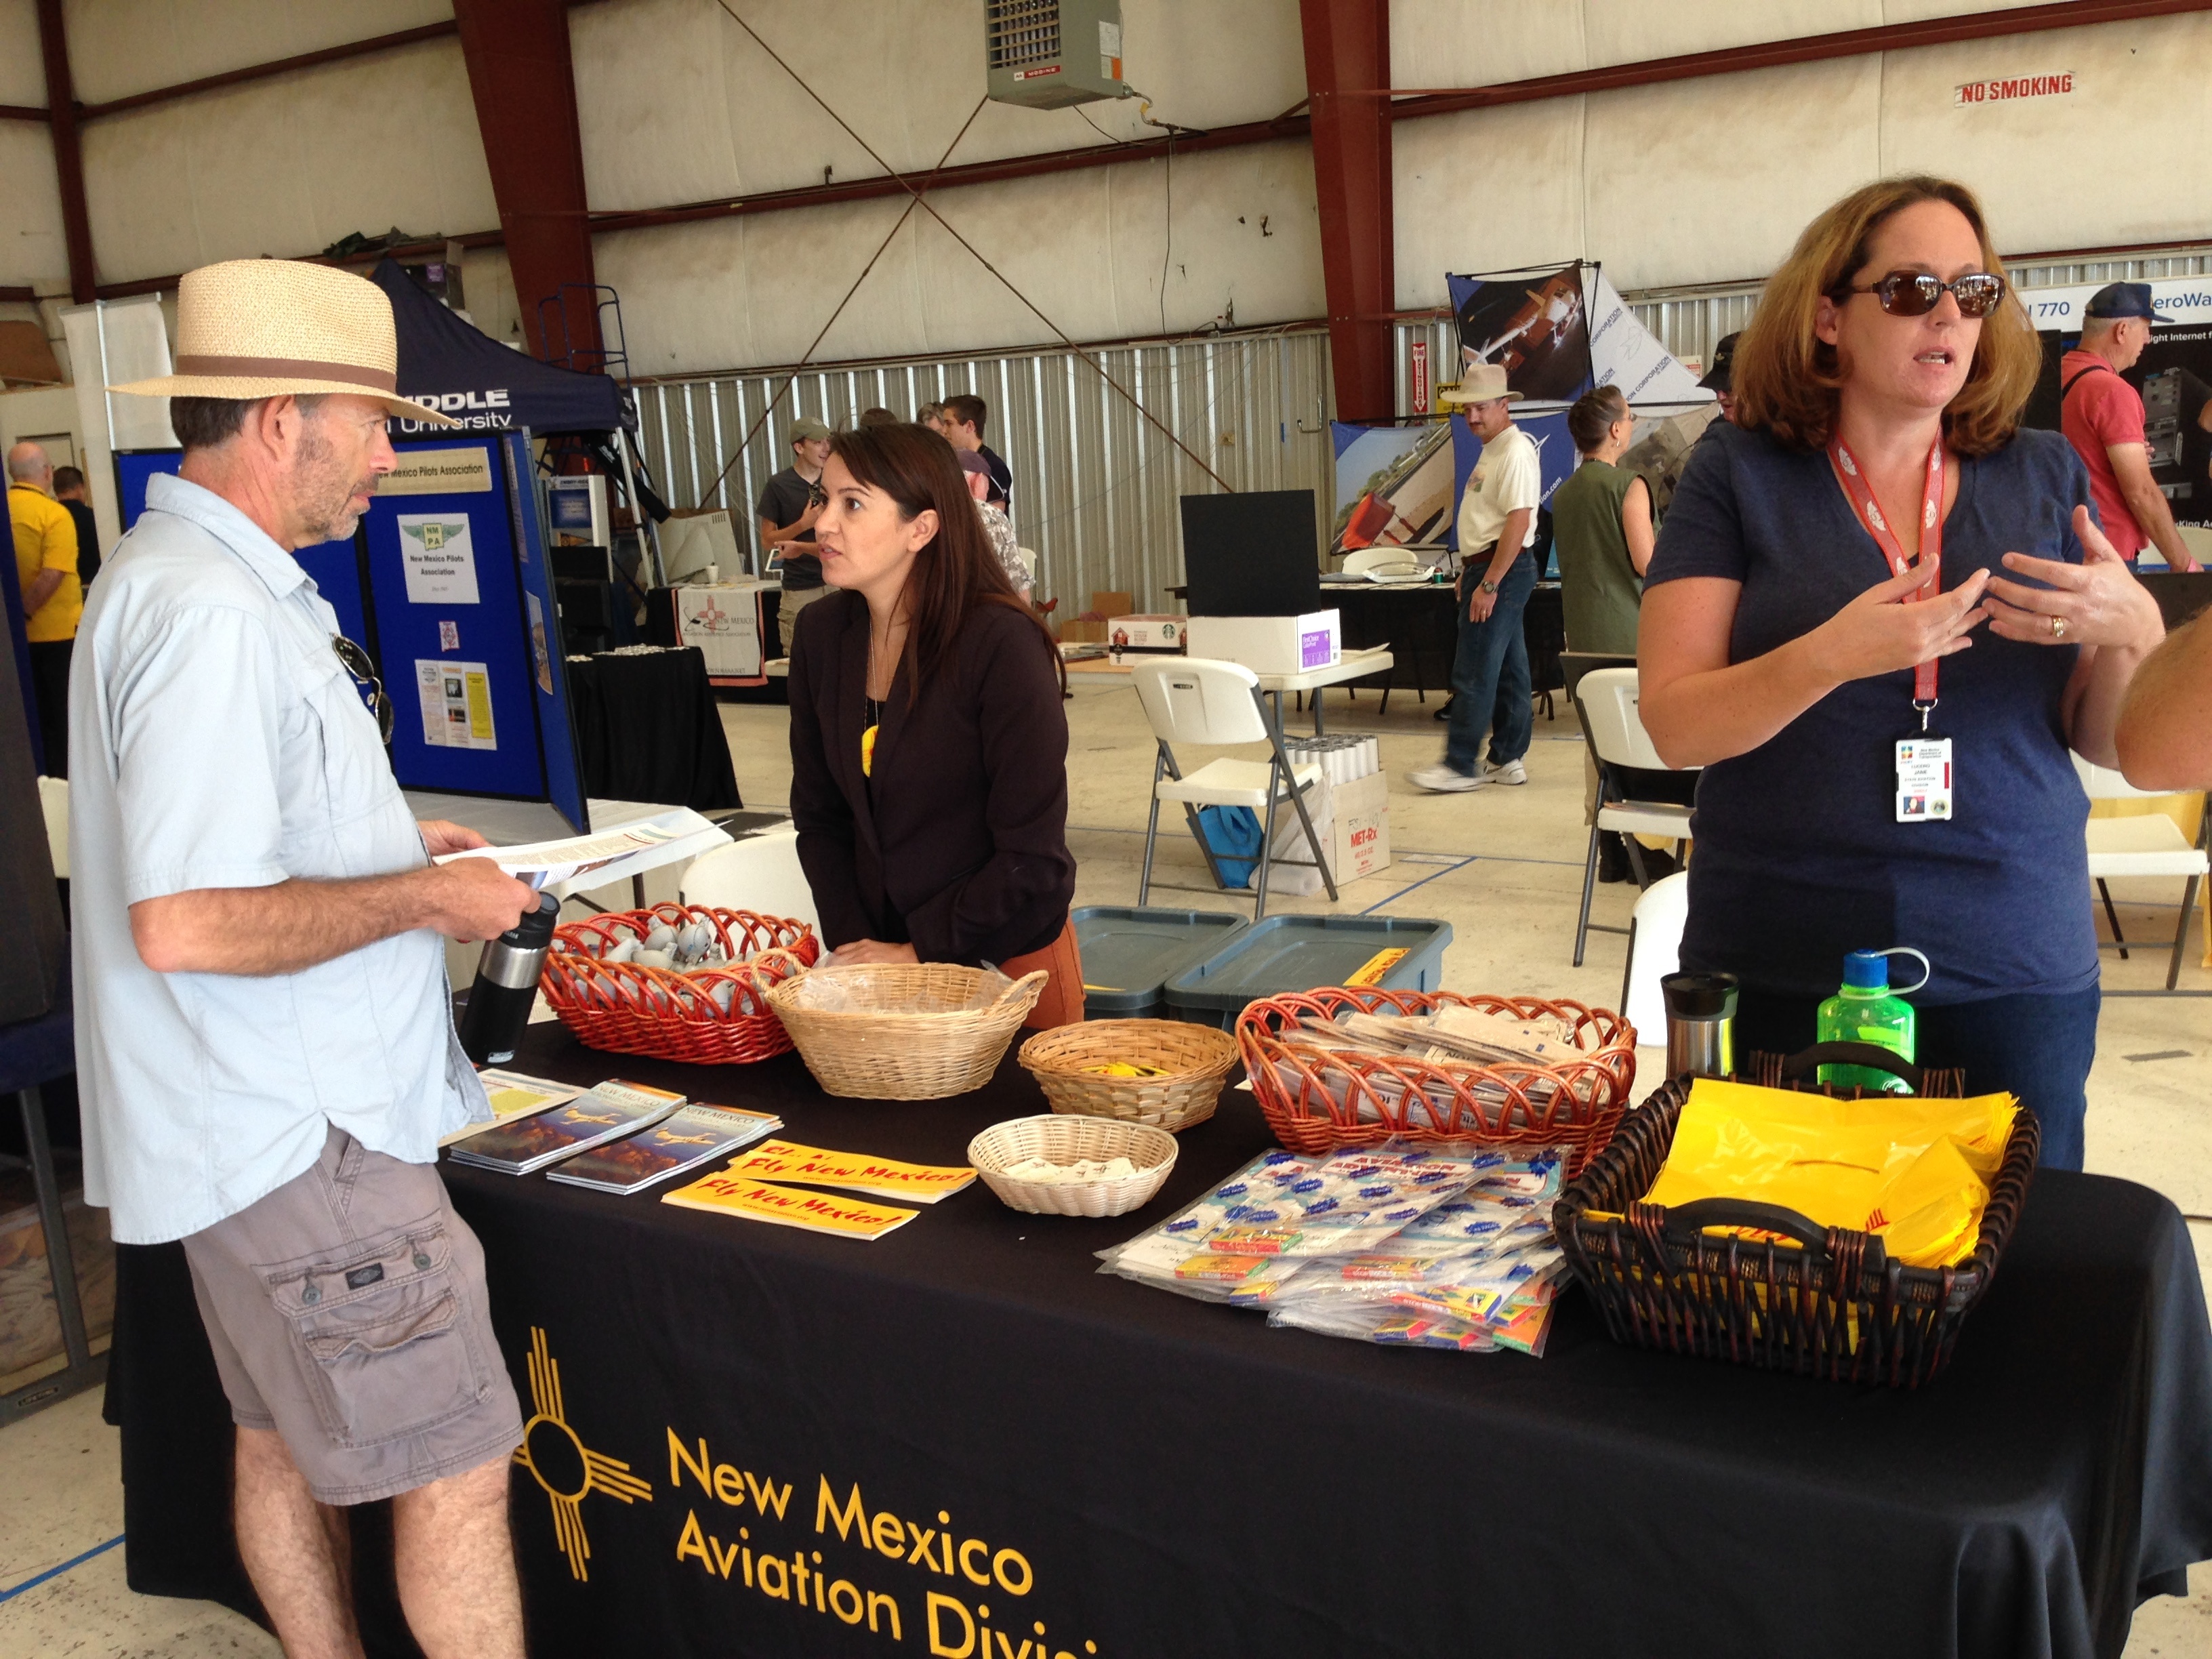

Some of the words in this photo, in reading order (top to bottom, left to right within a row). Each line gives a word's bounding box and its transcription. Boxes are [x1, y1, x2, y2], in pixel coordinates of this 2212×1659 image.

[1962, 83, 1985, 102] NO
[1989, 75, 2072, 100] SMOKING
[2039, 302, 2070, 317] 770
[2154, 292, 2212, 309] eroWa
[2171, 331, 2207, 341] Internet
[1635, 355, 1669, 392] CORPORATION
[391, 467, 417, 477] Mexico
[419, 465, 438, 476] Pilots
[441, 464, 483, 475] Association
[619, 1092, 661, 1106] MEXICO
[682, 1107, 711, 1116] NEW
[709, 1112, 755, 1124] MEXICO
[742, 1158, 791, 1174] Fly
[796, 1163, 856, 1176] New
[859, 1166, 972, 1183] Mexico!
[698, 1179, 744, 1196] Fly
[743, 1189, 800, 1207] New
[796, 1199, 902, 1226] Mexico!
[667, 1426, 793, 1522] New
[815, 1473, 1033, 1597] Mexico
[676, 1509, 901, 1641] Aviation
